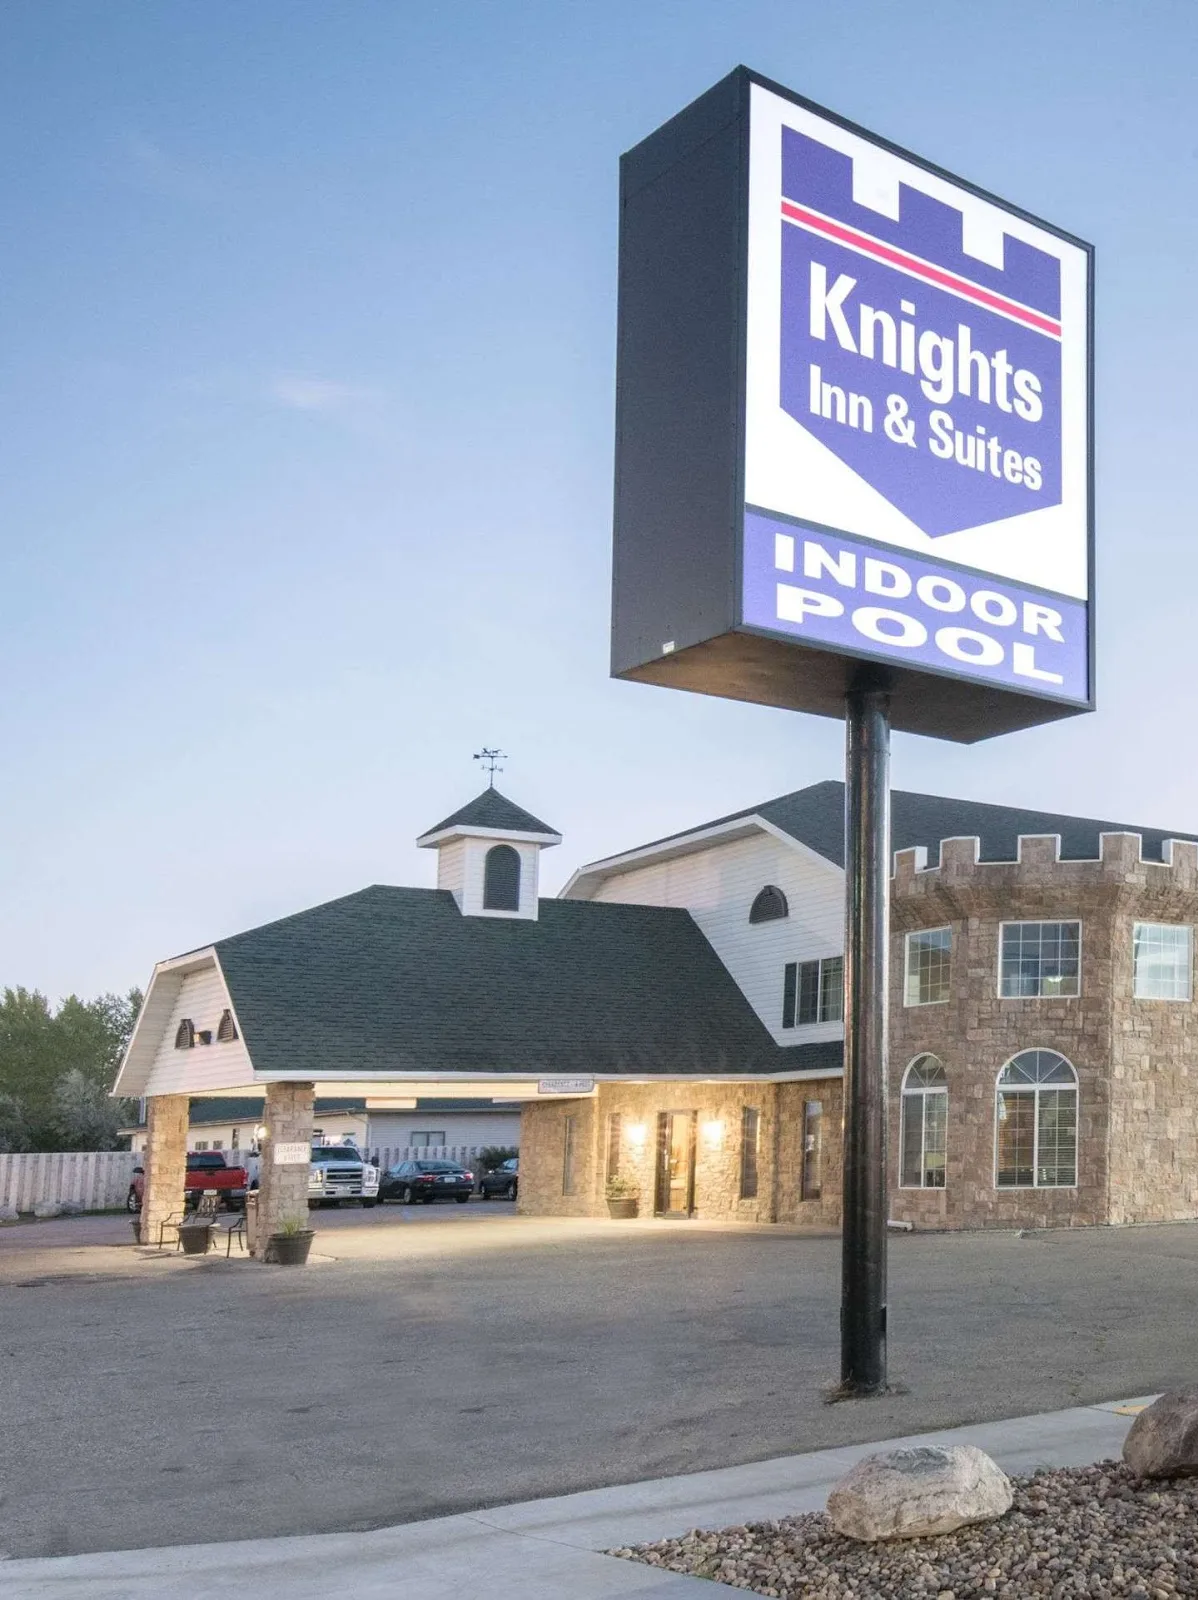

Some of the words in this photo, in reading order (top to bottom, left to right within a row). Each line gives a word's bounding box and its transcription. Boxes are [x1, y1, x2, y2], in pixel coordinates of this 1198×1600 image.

[809, 261, 1043, 422] Knights
[809, 363, 873, 433] Inn
[883, 393, 917, 448] &
[928, 409, 1043, 491] Suites
[774, 532, 1065, 643] INDOOR
[776, 583, 1064, 685] POOL
